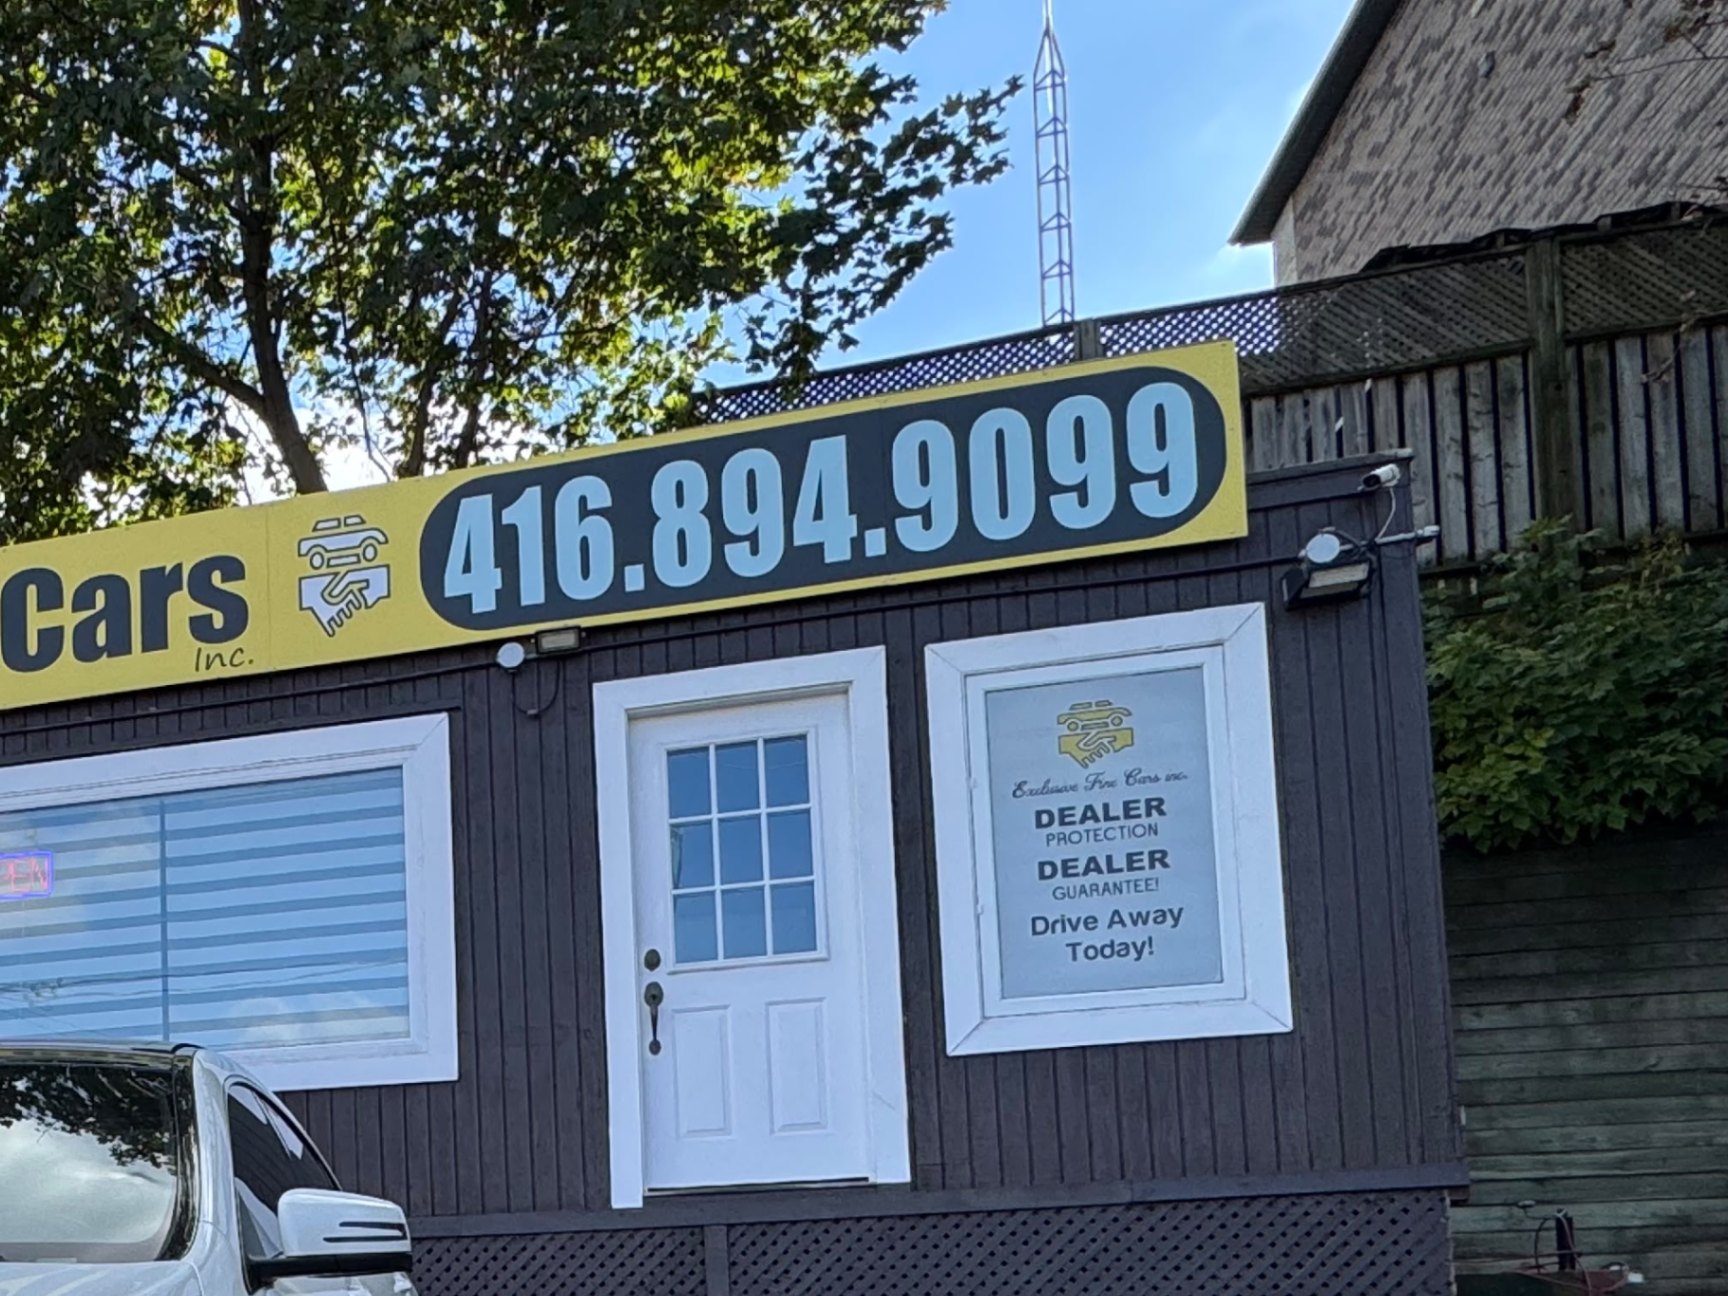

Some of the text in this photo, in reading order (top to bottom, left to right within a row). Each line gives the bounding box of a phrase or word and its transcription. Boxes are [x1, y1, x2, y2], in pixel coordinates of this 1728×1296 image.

[442, 381, 1200, 614] 416.894.9099
[194, 645, 254, 672] Inc.
[1012, 778, 1078, 798] Exclusive
[1084, 771, 1117, 792] Fine
[1124, 768, 1160, 787] Cars
[1035, 797, 1167, 829] DEALER
[1046, 822, 1159, 847] PROTECTION
[1038, 849, 1171, 881] DEALER
[1052, 877, 1159, 900] GUARANTEE!
[1031, 907, 1184, 936] Drive Away
[1066, 936, 1154, 962] Today!
